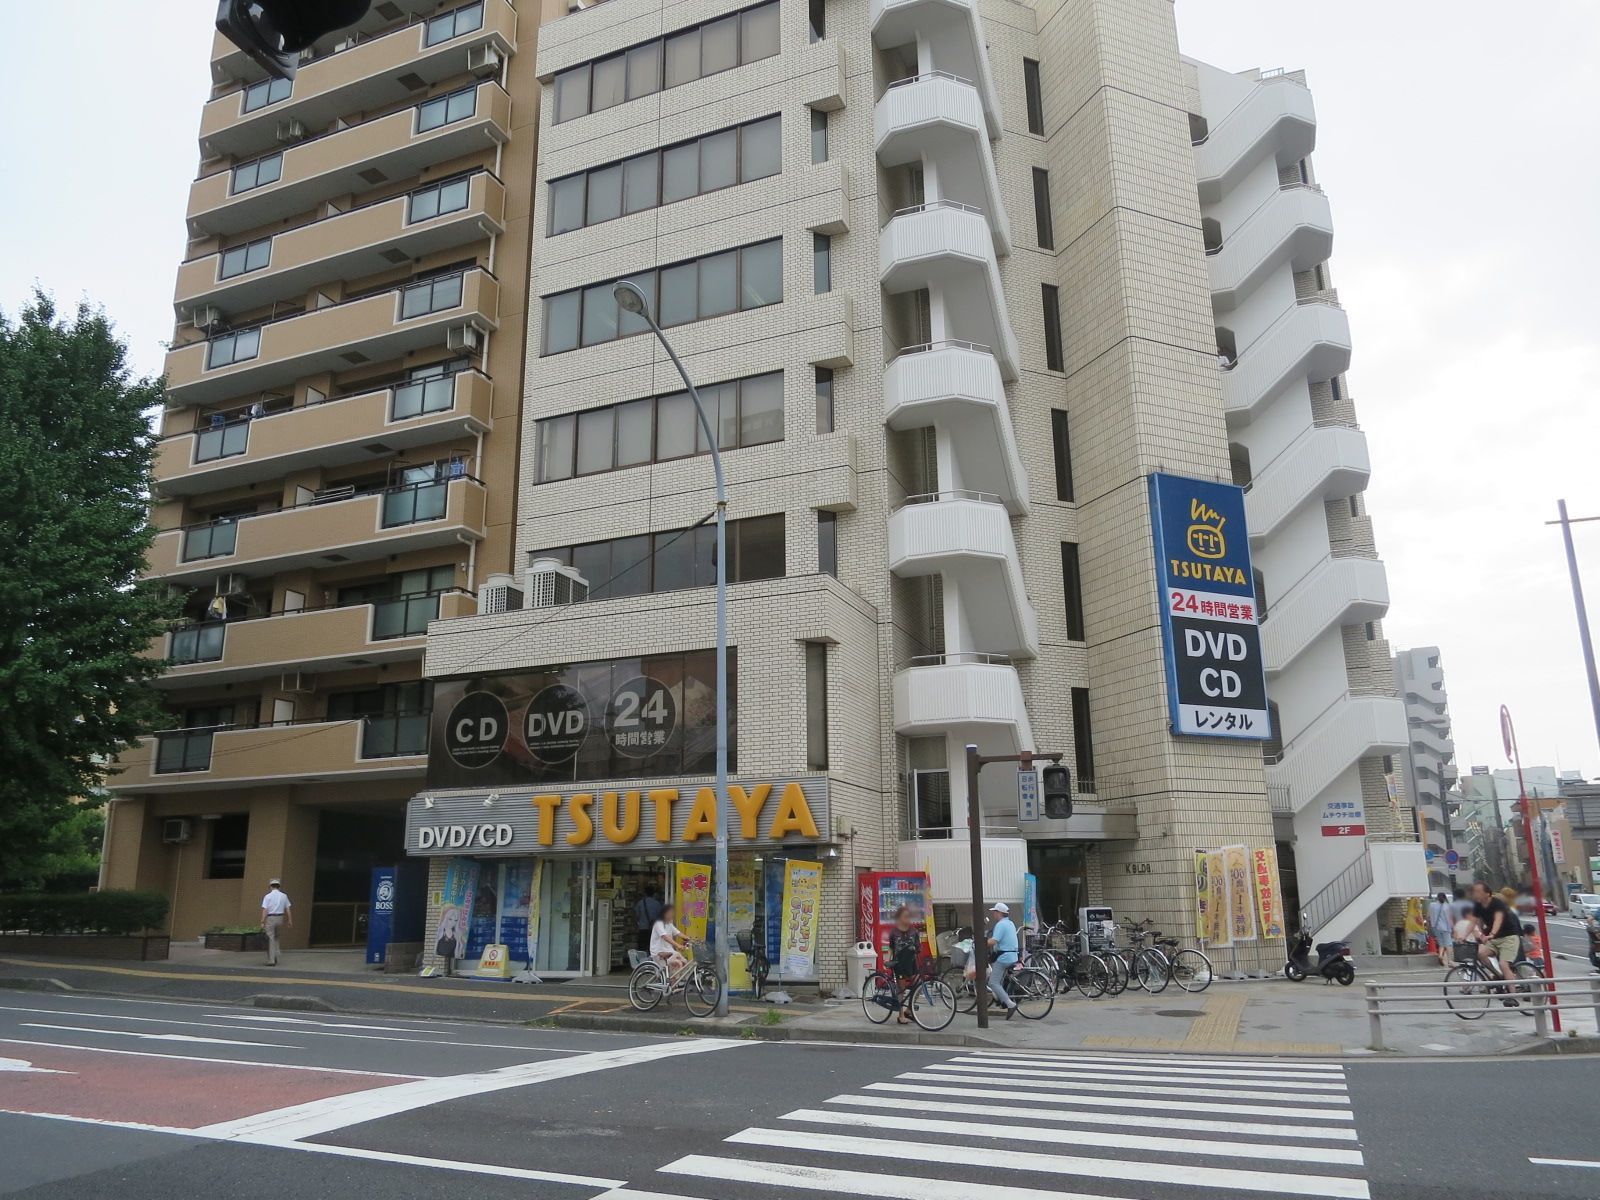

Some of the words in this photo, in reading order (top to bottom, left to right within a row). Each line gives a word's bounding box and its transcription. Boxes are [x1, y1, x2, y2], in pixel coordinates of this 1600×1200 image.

[1171, 560, 1247, 585] TSUTAYA
[1171, 592, 1253, 621] 24時間営業
[1184, 629, 1248, 661] DVD
[1200, 667, 1242, 698] CD
[613, 689, 668, 727] 24
[1195, 710, 1253, 731] レンタル
[455, 717, 498, 743] CD
[528, 710, 584, 737] DVD
[615, 730, 666, 747] 時間営業
[533, 783, 820, 846] TSUTAYA
[418, 823, 514, 849] DVD/CD
[1338, 826, 1351, 835] 2F
[375, 901, 393, 910] BOSS
